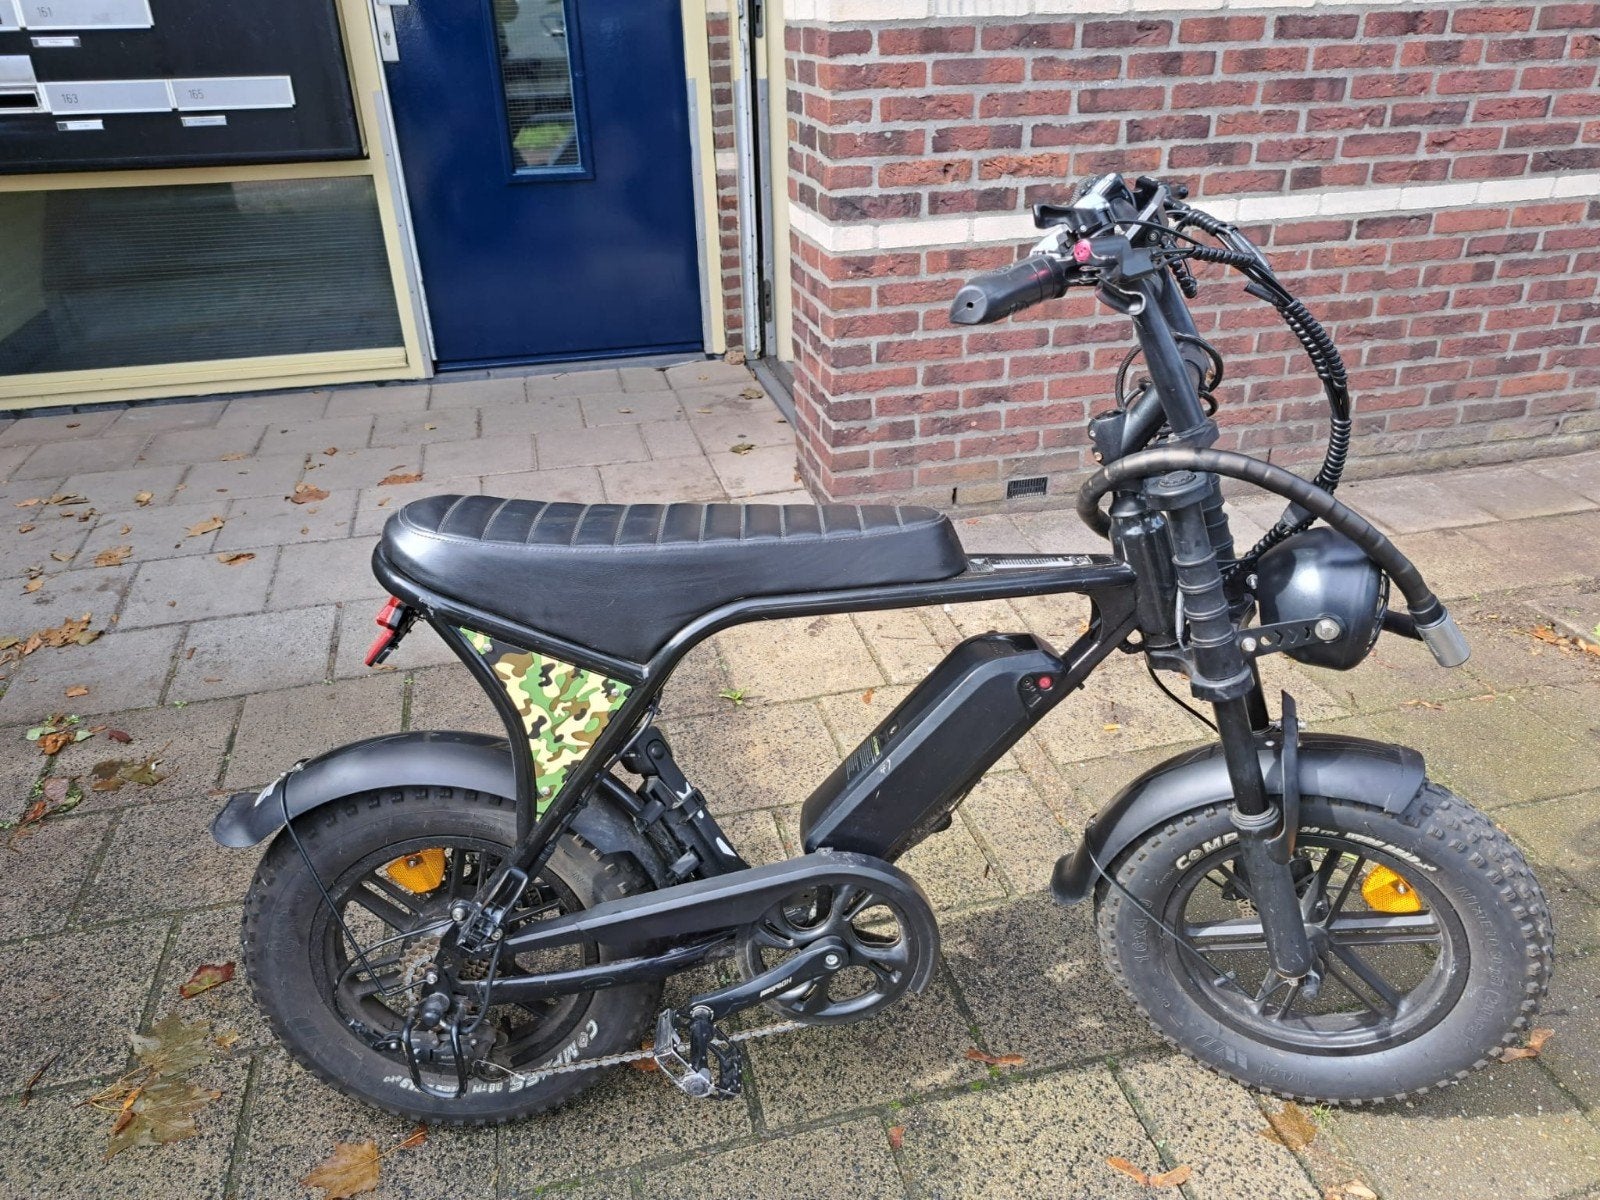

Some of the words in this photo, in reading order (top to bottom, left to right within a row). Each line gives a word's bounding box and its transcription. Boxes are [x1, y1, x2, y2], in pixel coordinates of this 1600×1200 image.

[36, 6, 53, 18] 161
[61, 93, 79, 104] 163
[187, 89, 205, 100] 165
[1175, 831, 1240, 870] COMP
